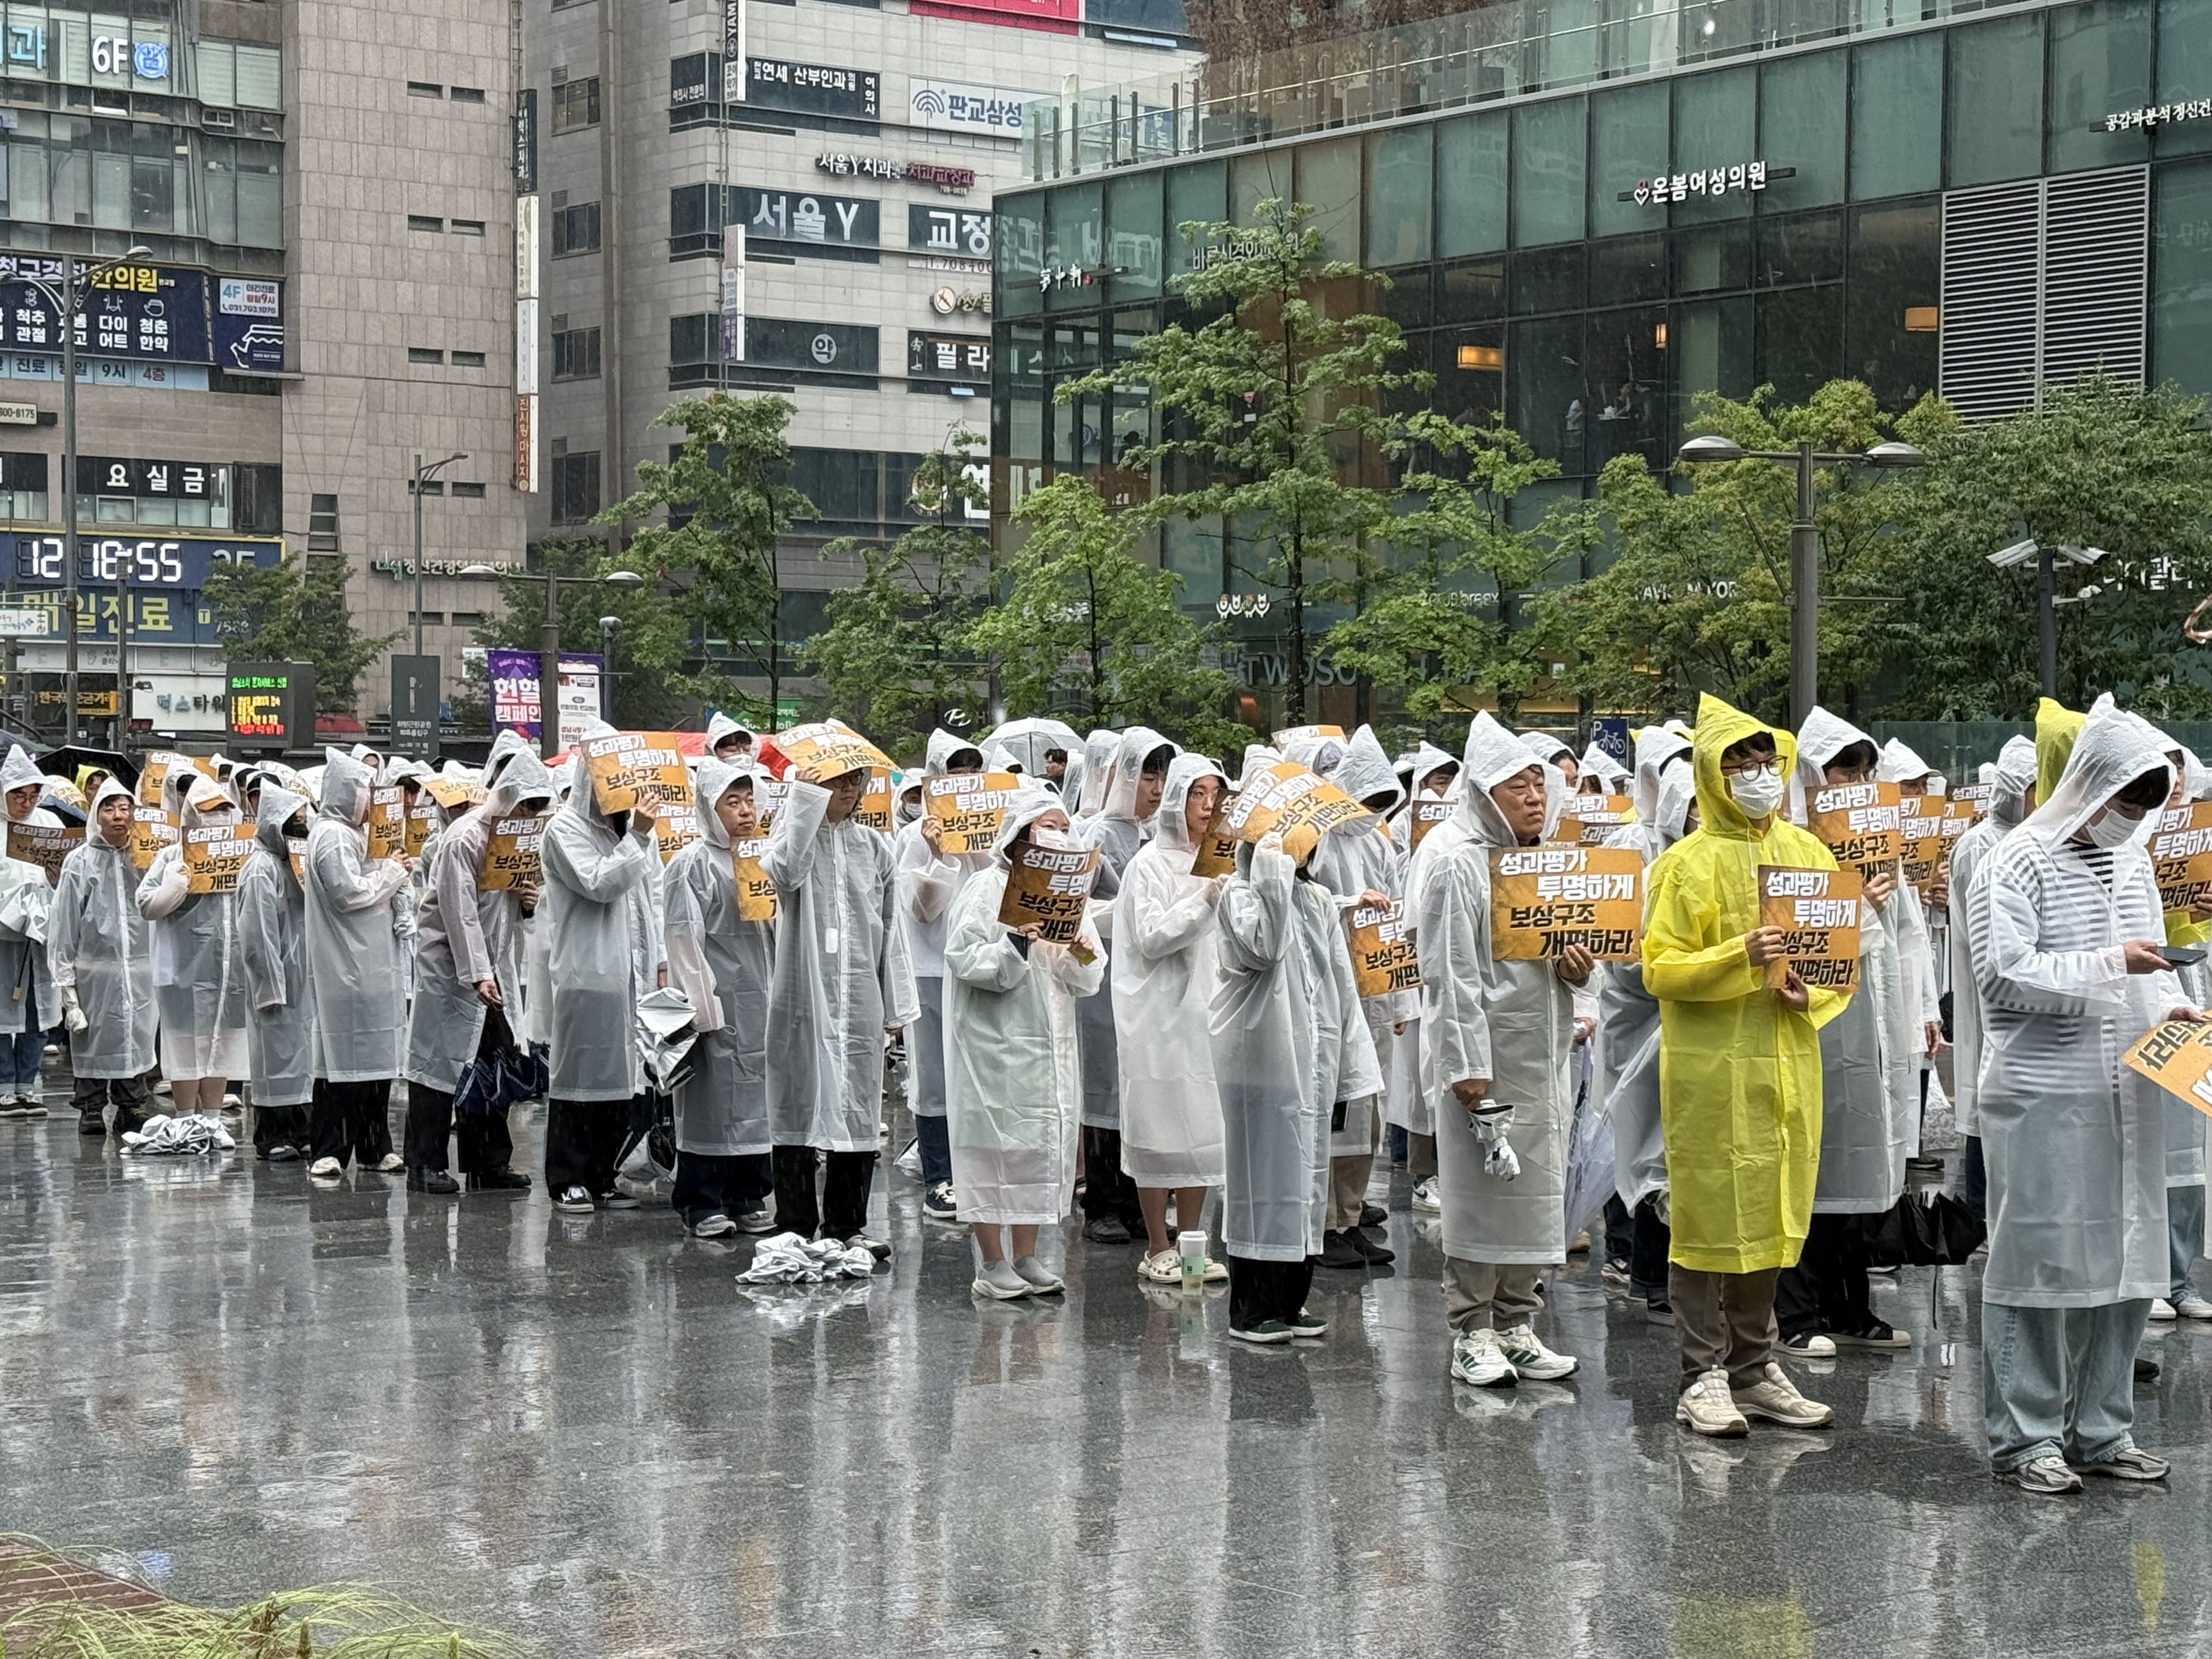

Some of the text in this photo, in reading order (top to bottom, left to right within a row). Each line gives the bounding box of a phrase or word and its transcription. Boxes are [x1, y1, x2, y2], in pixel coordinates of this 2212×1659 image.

[727, 0, 737, 37] YAM
[0, 21, 47, 70] 과
[92, 36, 128, 74] 6F
[762, 62, 788, 83] 연세
[794, 67, 847, 90] 산부인과
[865, 77, 876, 115] 여의사
[947, 94, 1022, 127] 판교삼성
[2105, 98, 2212, 132] 공감과분석 정신건
[819, 153, 891, 179] 서울Y치과
[1651, 161, 1766, 204] 온봄여성의원
[753, 194, 859, 240] 서울Y
[927, 211, 991, 255] 교정
[223, 284, 241, 299] 4F
[16, 308, 46, 326] 척추
[99, 315, 128, 331] 다이
[139, 318, 168, 335] 청춘
[16, 327, 46, 344] 관절
[99, 334, 128, 349] 어트
[139, 335, 168, 352] 한약
[815, 336, 833, 362] 약
[17, 358, 46, 373] 진료
[102, 364, 126, 380] 9시
[143, 366, 166, 382] 4층
[519, 439, 529, 479] 마사지
[33, 539, 63, 578] 12
[23, 592, 173, 634] 매일진료
[493, 678, 540, 704] 헌혈
[495, 704, 541, 723] 캠페인
[1593, 721, 1602, 737] P
[588, 735, 646, 758] 성과평가
[618, 749, 679, 768] 투명하게
[808, 743, 866, 764] 보상구조
[606, 768, 663, 791] 보상구조
[929, 775, 985, 796] 성과평가
[1262, 772, 1326, 813] 투명하게
[630, 785, 687, 804] 개편하라
[1228, 770, 1282, 829] 성과평가
[1815, 783, 1880, 813] 성과평가
[495, 819, 544, 835] 성과평가
[942, 812, 996, 833] 보상구조
[1270, 792, 1327, 838] 보상구조
[1302, 797, 1365, 836] 개편하라
[1848, 806, 1900, 836] 투명하게
[1900, 815, 1942, 840] 명하게
[13, 824, 65, 839] 성과평가
[187, 825, 235, 843] 성과평가
[963, 832, 997, 851] 개편
[1024, 848, 1091, 873] 성과평가
[1830, 834, 1890, 861] 보상구조
[194, 857, 241, 875] 보상구조
[493, 854, 541, 871] 보상구조
[1499, 849, 1588, 875] 성과평가
[2154, 859, 2191, 885] 구조
[1047, 873, 1092, 897] 투명
[1536, 873, 1634, 902] 투명하게
[1766, 872, 1830, 897] 성과평가
[1018, 891, 1085, 917] 보상구조
[1510, 904, 1596, 928] 보상구조
[1794, 899, 1857, 929] 투명하게
[1538, 929, 1634, 957] 개편하라
[1780, 931, 1831, 956] 상구조
[1365, 943, 1418, 970] 보상구조
